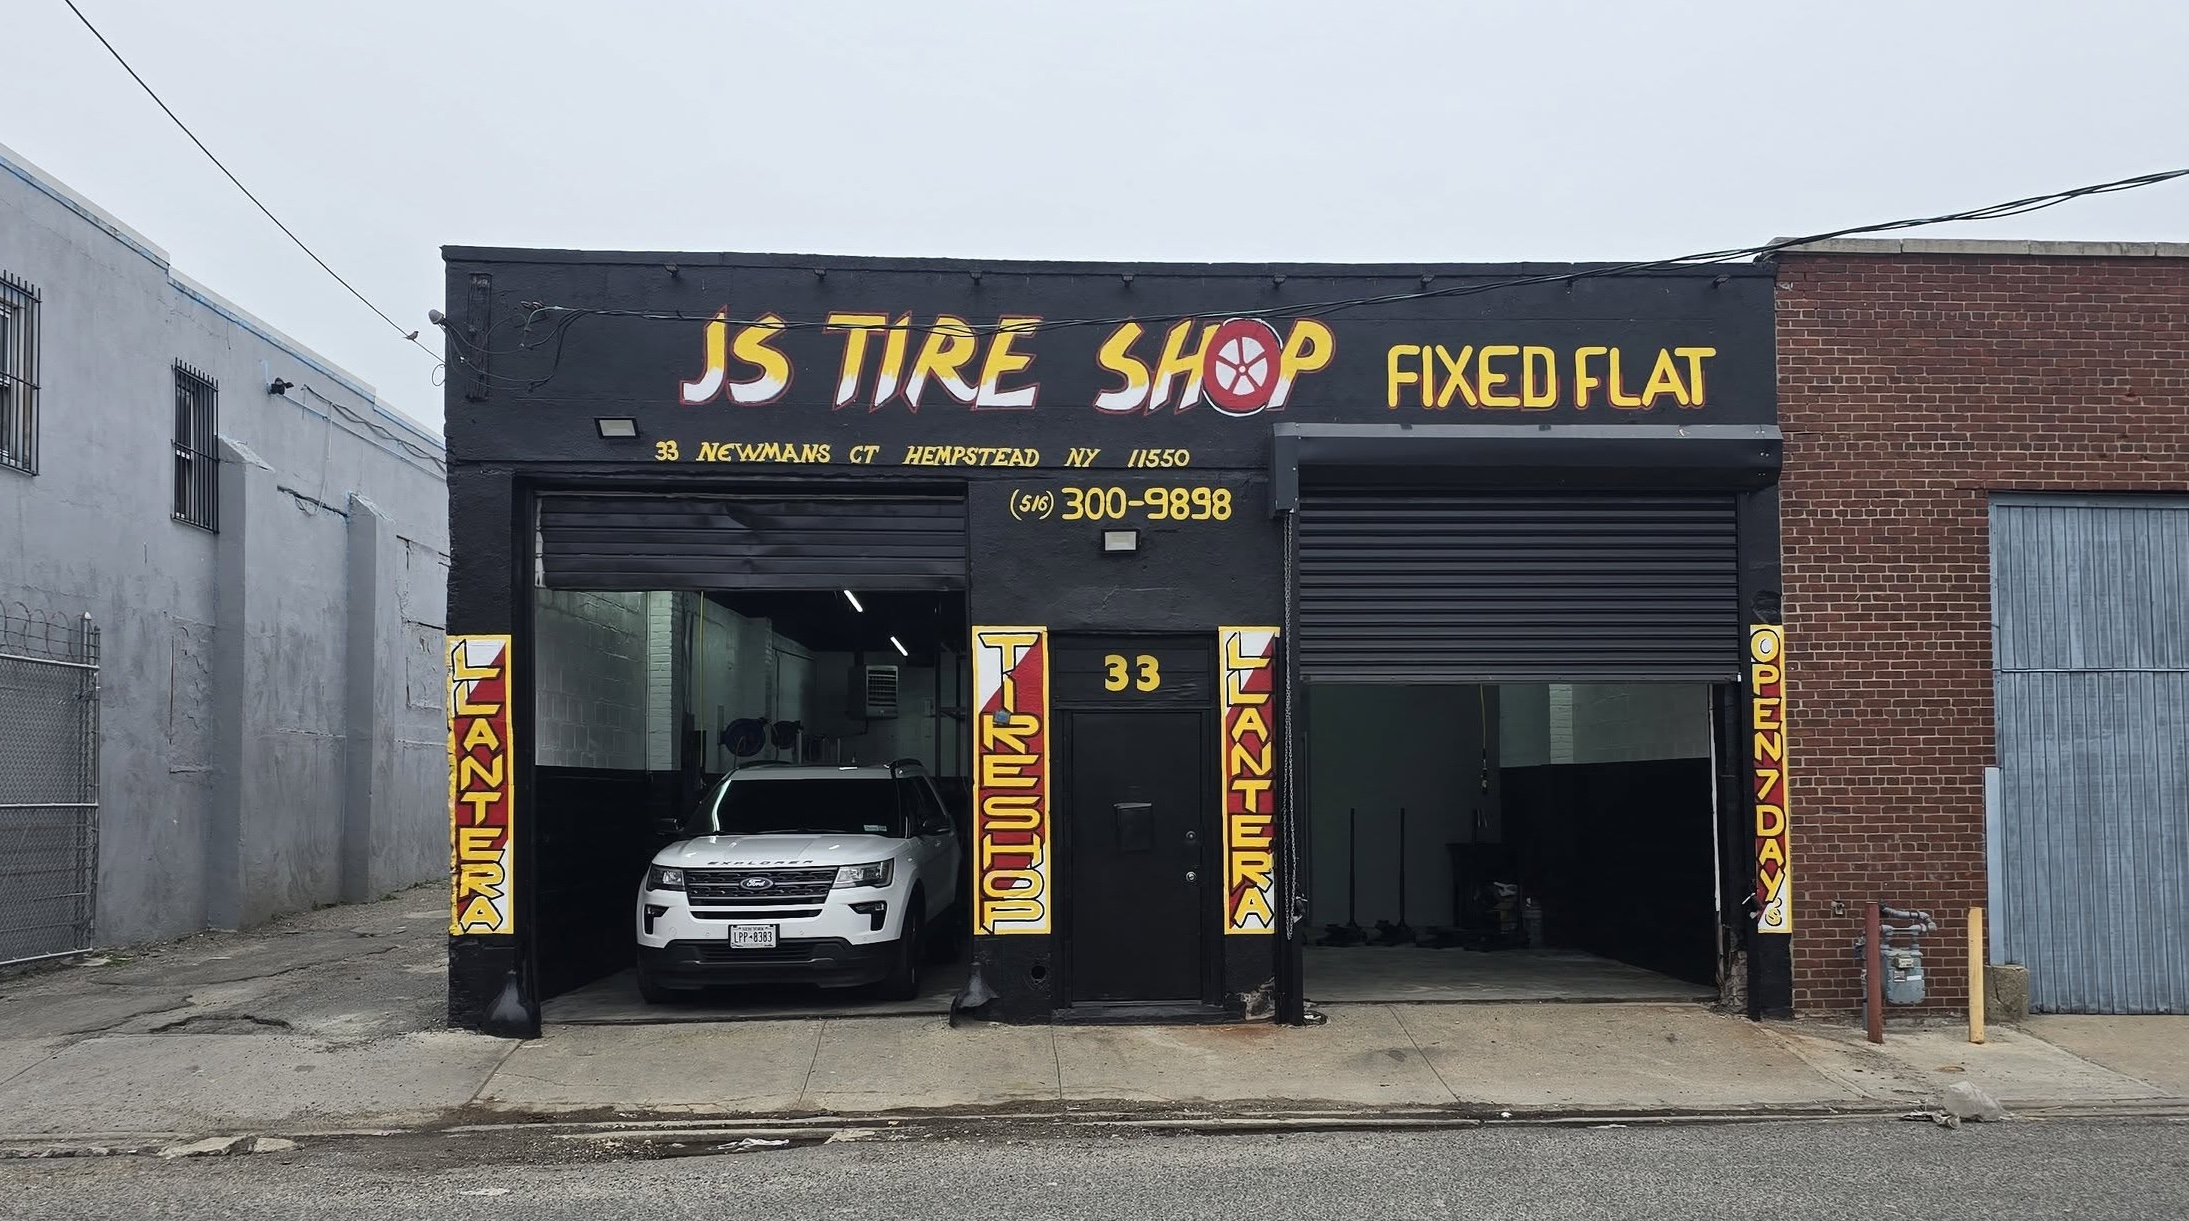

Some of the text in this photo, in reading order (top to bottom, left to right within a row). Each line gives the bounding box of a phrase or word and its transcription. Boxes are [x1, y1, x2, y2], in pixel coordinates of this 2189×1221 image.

[680, 304, 1336, 416] JS TIRE SHOP
[1387, 344, 1717, 410] FIXED FLAT
[655, 440, 1191, 467] 33 NEWMANS CT HEMPSTEAD NY 11550
[1010, 486, 1232, 521] (516) 300-9898
[1103, 654, 1162, 693] 33
[451, 639, 505, 932] LLANTERA
[1226, 631, 1275, 929] LLANTERA
